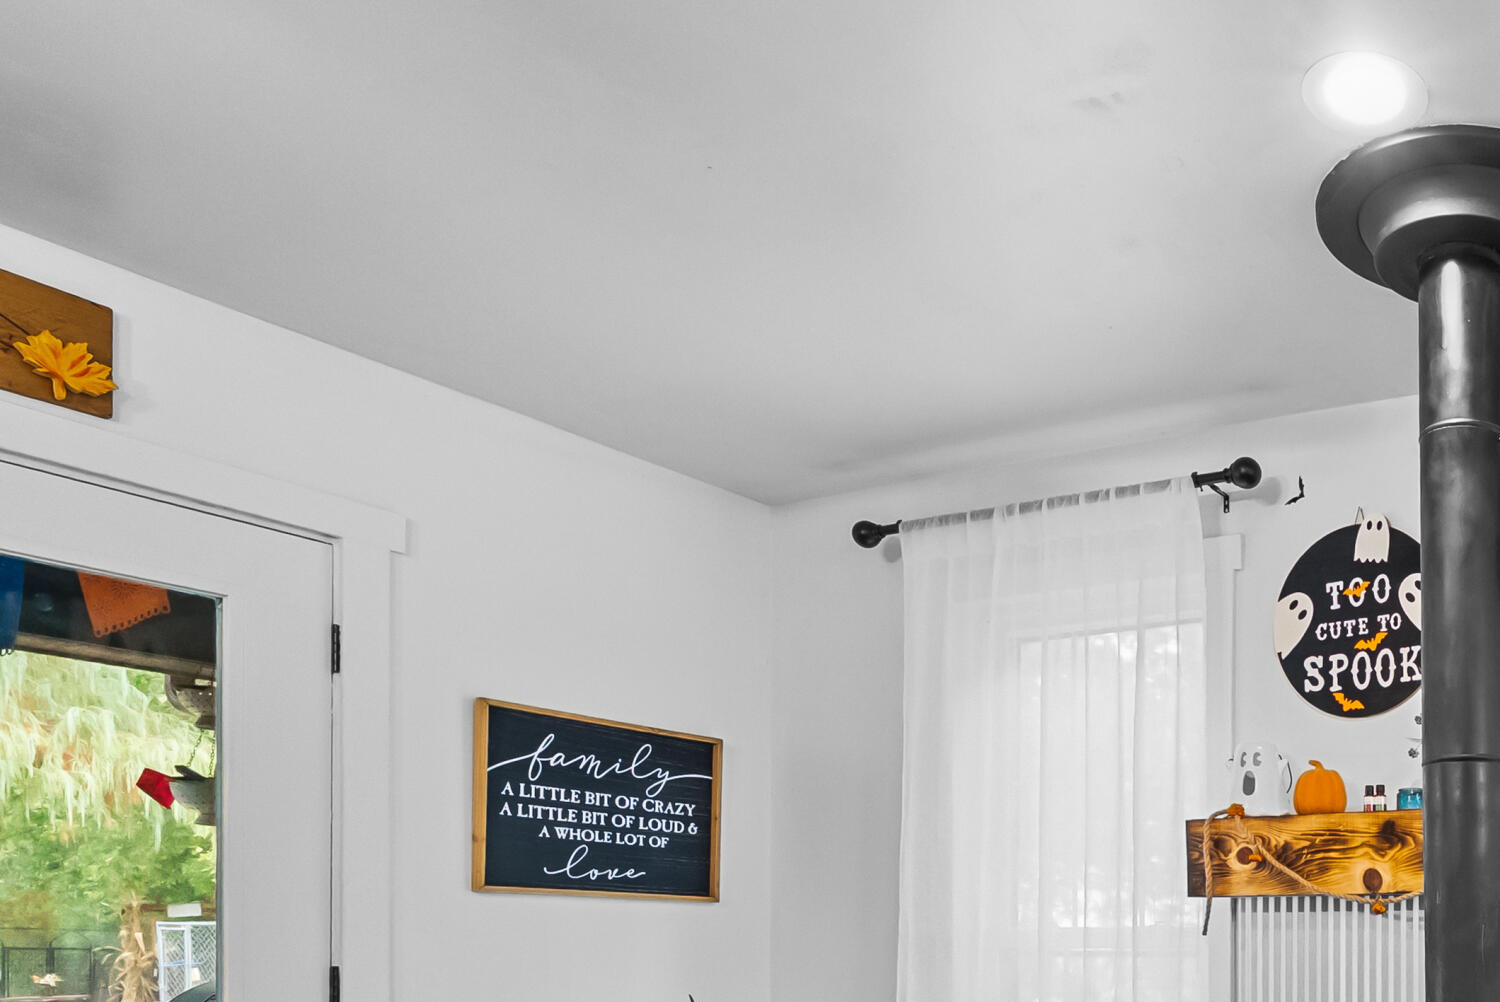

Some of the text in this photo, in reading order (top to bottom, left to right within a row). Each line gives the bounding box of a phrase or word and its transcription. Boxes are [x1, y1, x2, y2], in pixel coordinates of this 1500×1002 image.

[1325, 573, 1391, 609] TOO
[1315, 613, 1401, 641] CUTE TO
[1303, 645, 1422, 692] SPOOK
[487, 733, 713, 797] family
[501, 782, 696, 817] A LITTLE BIT OF CRAZY
[499, 802, 698, 835] A LITTLE BIT OF LOUD &
[539, 825, 670, 848] A WHOLE LOT OF
[543, 844, 646, 880] love
